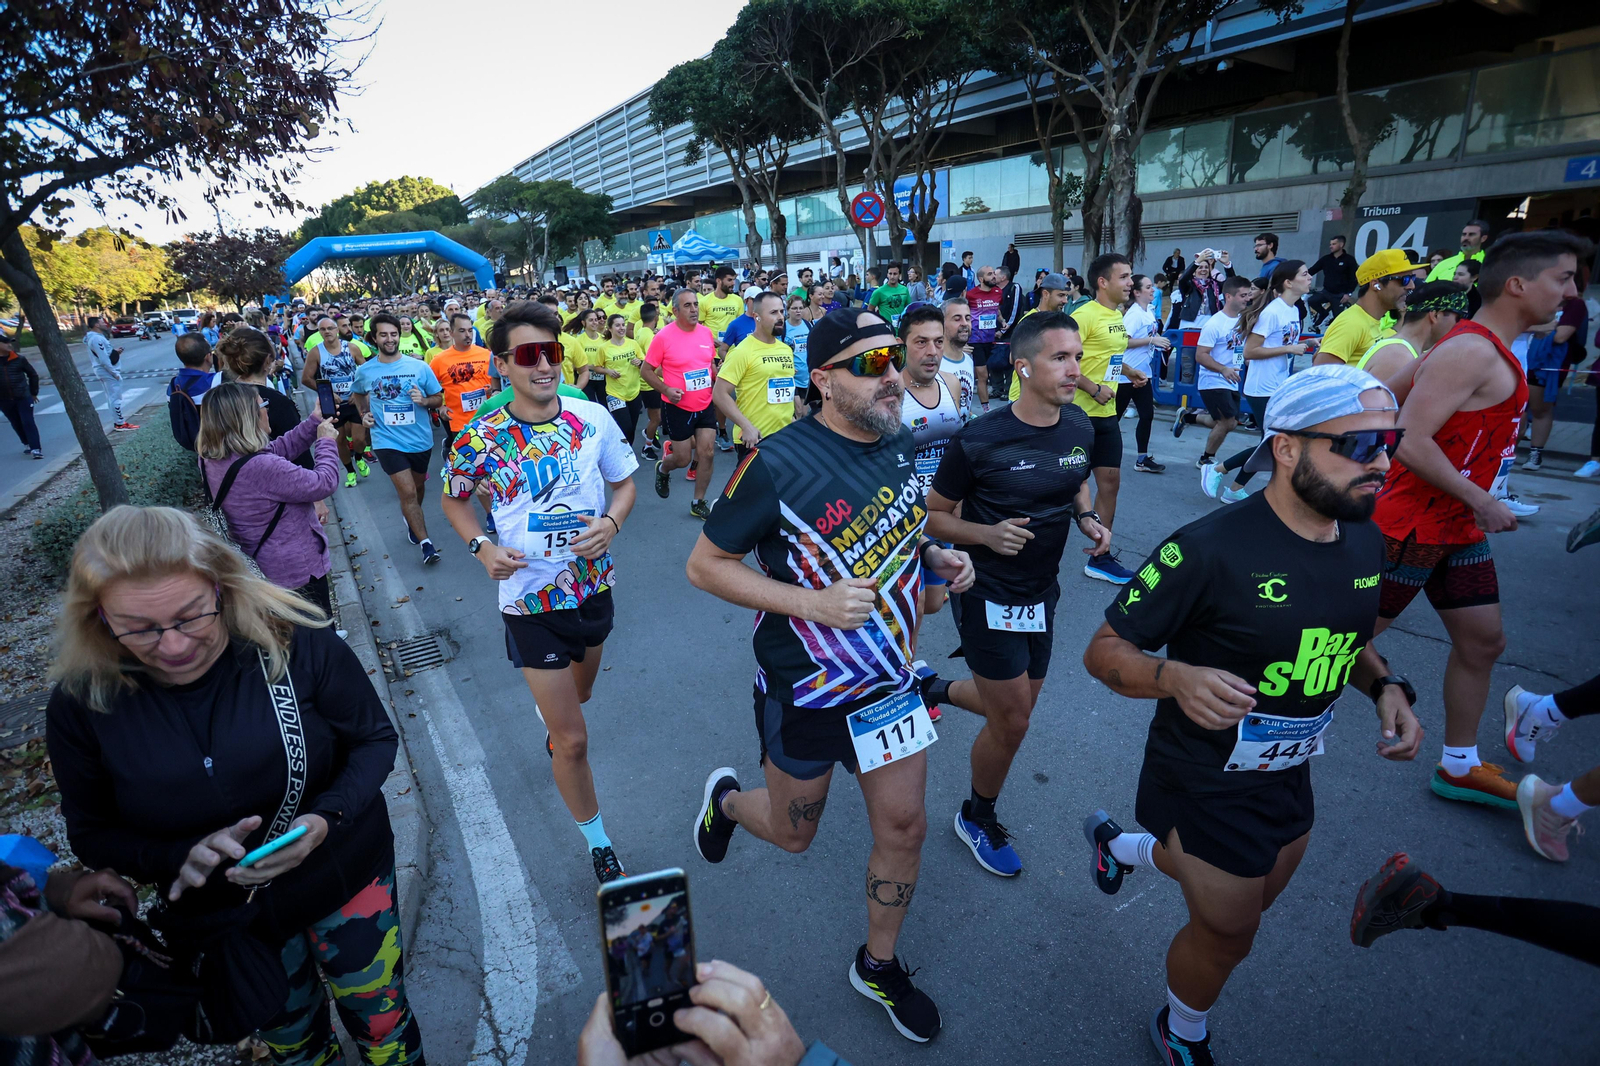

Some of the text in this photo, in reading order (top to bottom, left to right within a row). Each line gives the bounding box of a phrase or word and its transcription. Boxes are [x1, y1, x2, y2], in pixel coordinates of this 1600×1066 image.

[1580, 160, 1597, 178] 4
[1362, 206, 1402, 217] Tribuna
[1354, 216, 1429, 266] 04
[1108, 325, 1127, 333] FITNE
[612, 351, 636, 361] FITNESS
[762, 356, 792, 364] FITNESS
[692, 377, 706, 386] 173
[775, 388, 791, 397] 975
[468, 397, 482, 407] 377
[609, 400, 621, 408] 530
[393, 413, 406, 421] 13
[816, 499, 853, 535] edp
[831, 486, 895, 553] MEDIO
[842, 472, 920, 566] MARATÓN
[544, 530, 580, 549] 153
[853, 505, 926, 578] SEVILLA
[1002, 604, 1036, 620] 378
[859, 708, 874, 719] XLIII
[874, 699, 894, 713] Carrera
[868, 711, 890, 724] Ciudad
[897, 700, 910, 711] Jerez
[271, 684, 304, 773] ENDLESS
[1259, 718, 1313, 729] XLIII Carrera
[875, 715, 915, 750] 117
